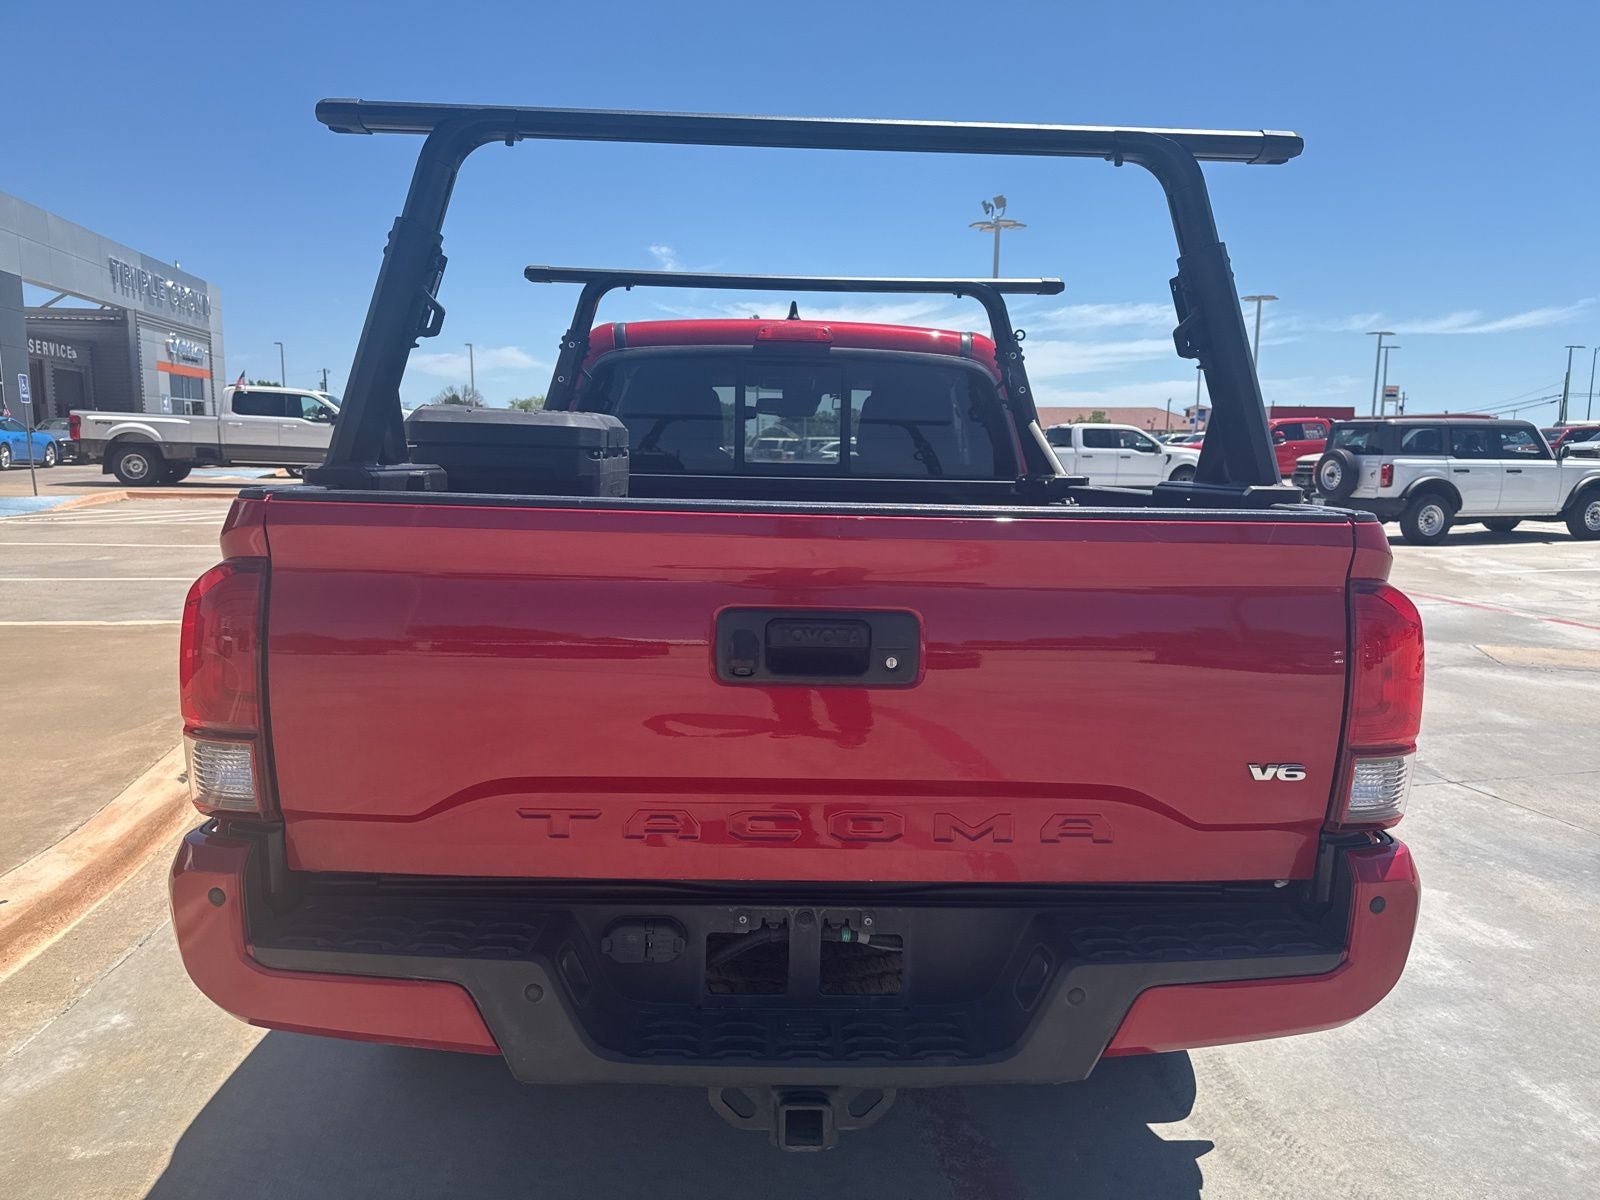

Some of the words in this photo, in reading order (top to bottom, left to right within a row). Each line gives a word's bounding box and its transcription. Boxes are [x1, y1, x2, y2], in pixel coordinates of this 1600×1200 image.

[109, 256, 166, 301] TRIPLE
[784, 627, 860, 643] TOYOTA
[1248, 763, 1307, 782] V6
[515, 807, 1114, 843] TACOMA
